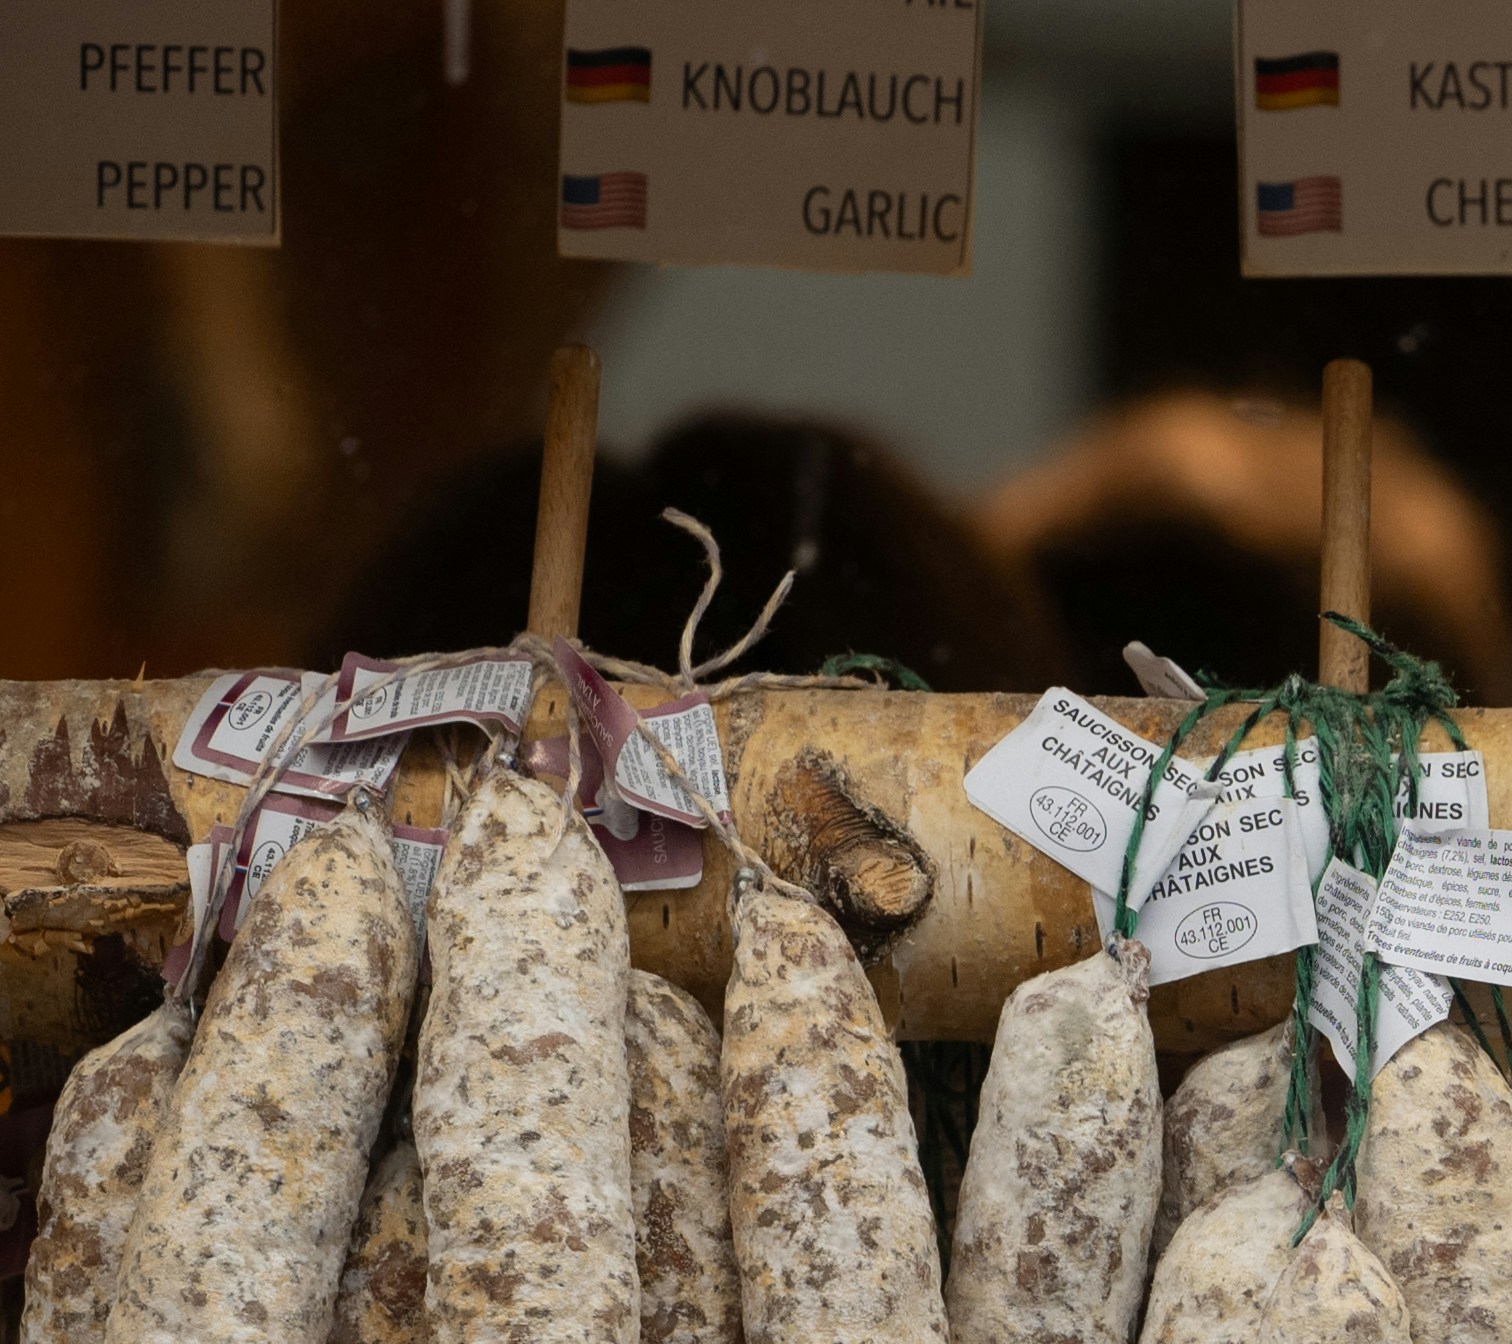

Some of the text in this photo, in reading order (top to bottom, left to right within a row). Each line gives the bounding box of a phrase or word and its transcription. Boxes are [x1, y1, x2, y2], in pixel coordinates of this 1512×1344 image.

[78, 41, 267, 98] PFEFFER
[680, 60, 964, 127] KNOBLAUCH
[94, 159, 267, 214] PEPPER
[800, 185, 961, 244] GARLIC
[1053, 699, 1157, 771] SAUCISSON
[1091, 746, 1137, 779] AUX
[1441, 760, 1480, 779] SEC
[1035, 794, 1101, 845] 43.112.001
[1067, 797, 1088, 817] FR
[1239, 809, 1284, 834] SEC
[1049, 821, 1072, 842] CE
[1456, 836, 1482, 849] viande
[1487, 839, 1498, 850] de
[1178, 844, 1223, 872] AUX
[1392, 851, 1405, 864] de
[1466, 867, 1500, 882] légumes
[1151, 856, 1275, 903] HÂTAIGNES
[1202, 906, 1223, 925] FR
[1394, 915, 1406, 927] de
[1407, 918, 1436, 933] viande
[1436, 924, 1448, 935] de
[1449, 925, 1468, 938] porc
[1180, 916, 1251, 946] 43.112.001
[1208, 935, 1230, 954] CE
[1366, 929, 1393, 953] Traces
[1446, 952, 1459, 965] de
[1459, 954, 1484, 970] fruits
[1483, 957, 1491, 970] à
